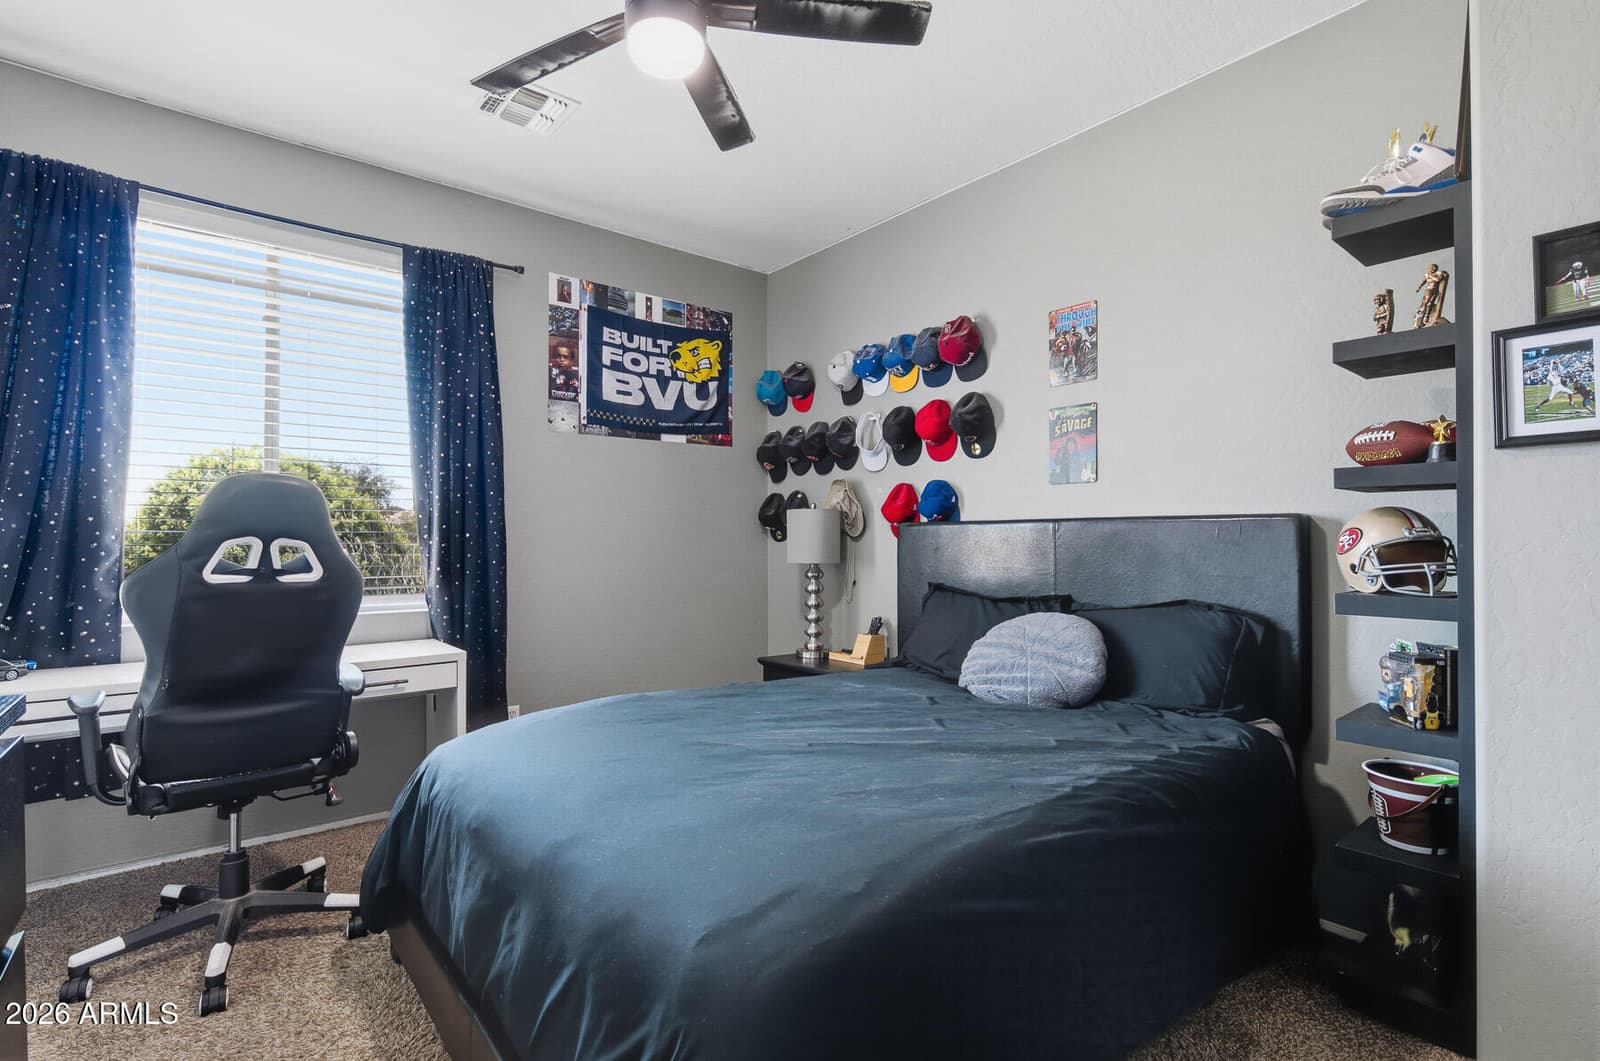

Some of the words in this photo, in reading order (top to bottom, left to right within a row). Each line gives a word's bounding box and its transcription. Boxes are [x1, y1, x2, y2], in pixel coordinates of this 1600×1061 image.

[602, 326, 672, 354] BUILT
[602, 344, 672, 377] FOR
[602, 367, 719, 411] BVU
